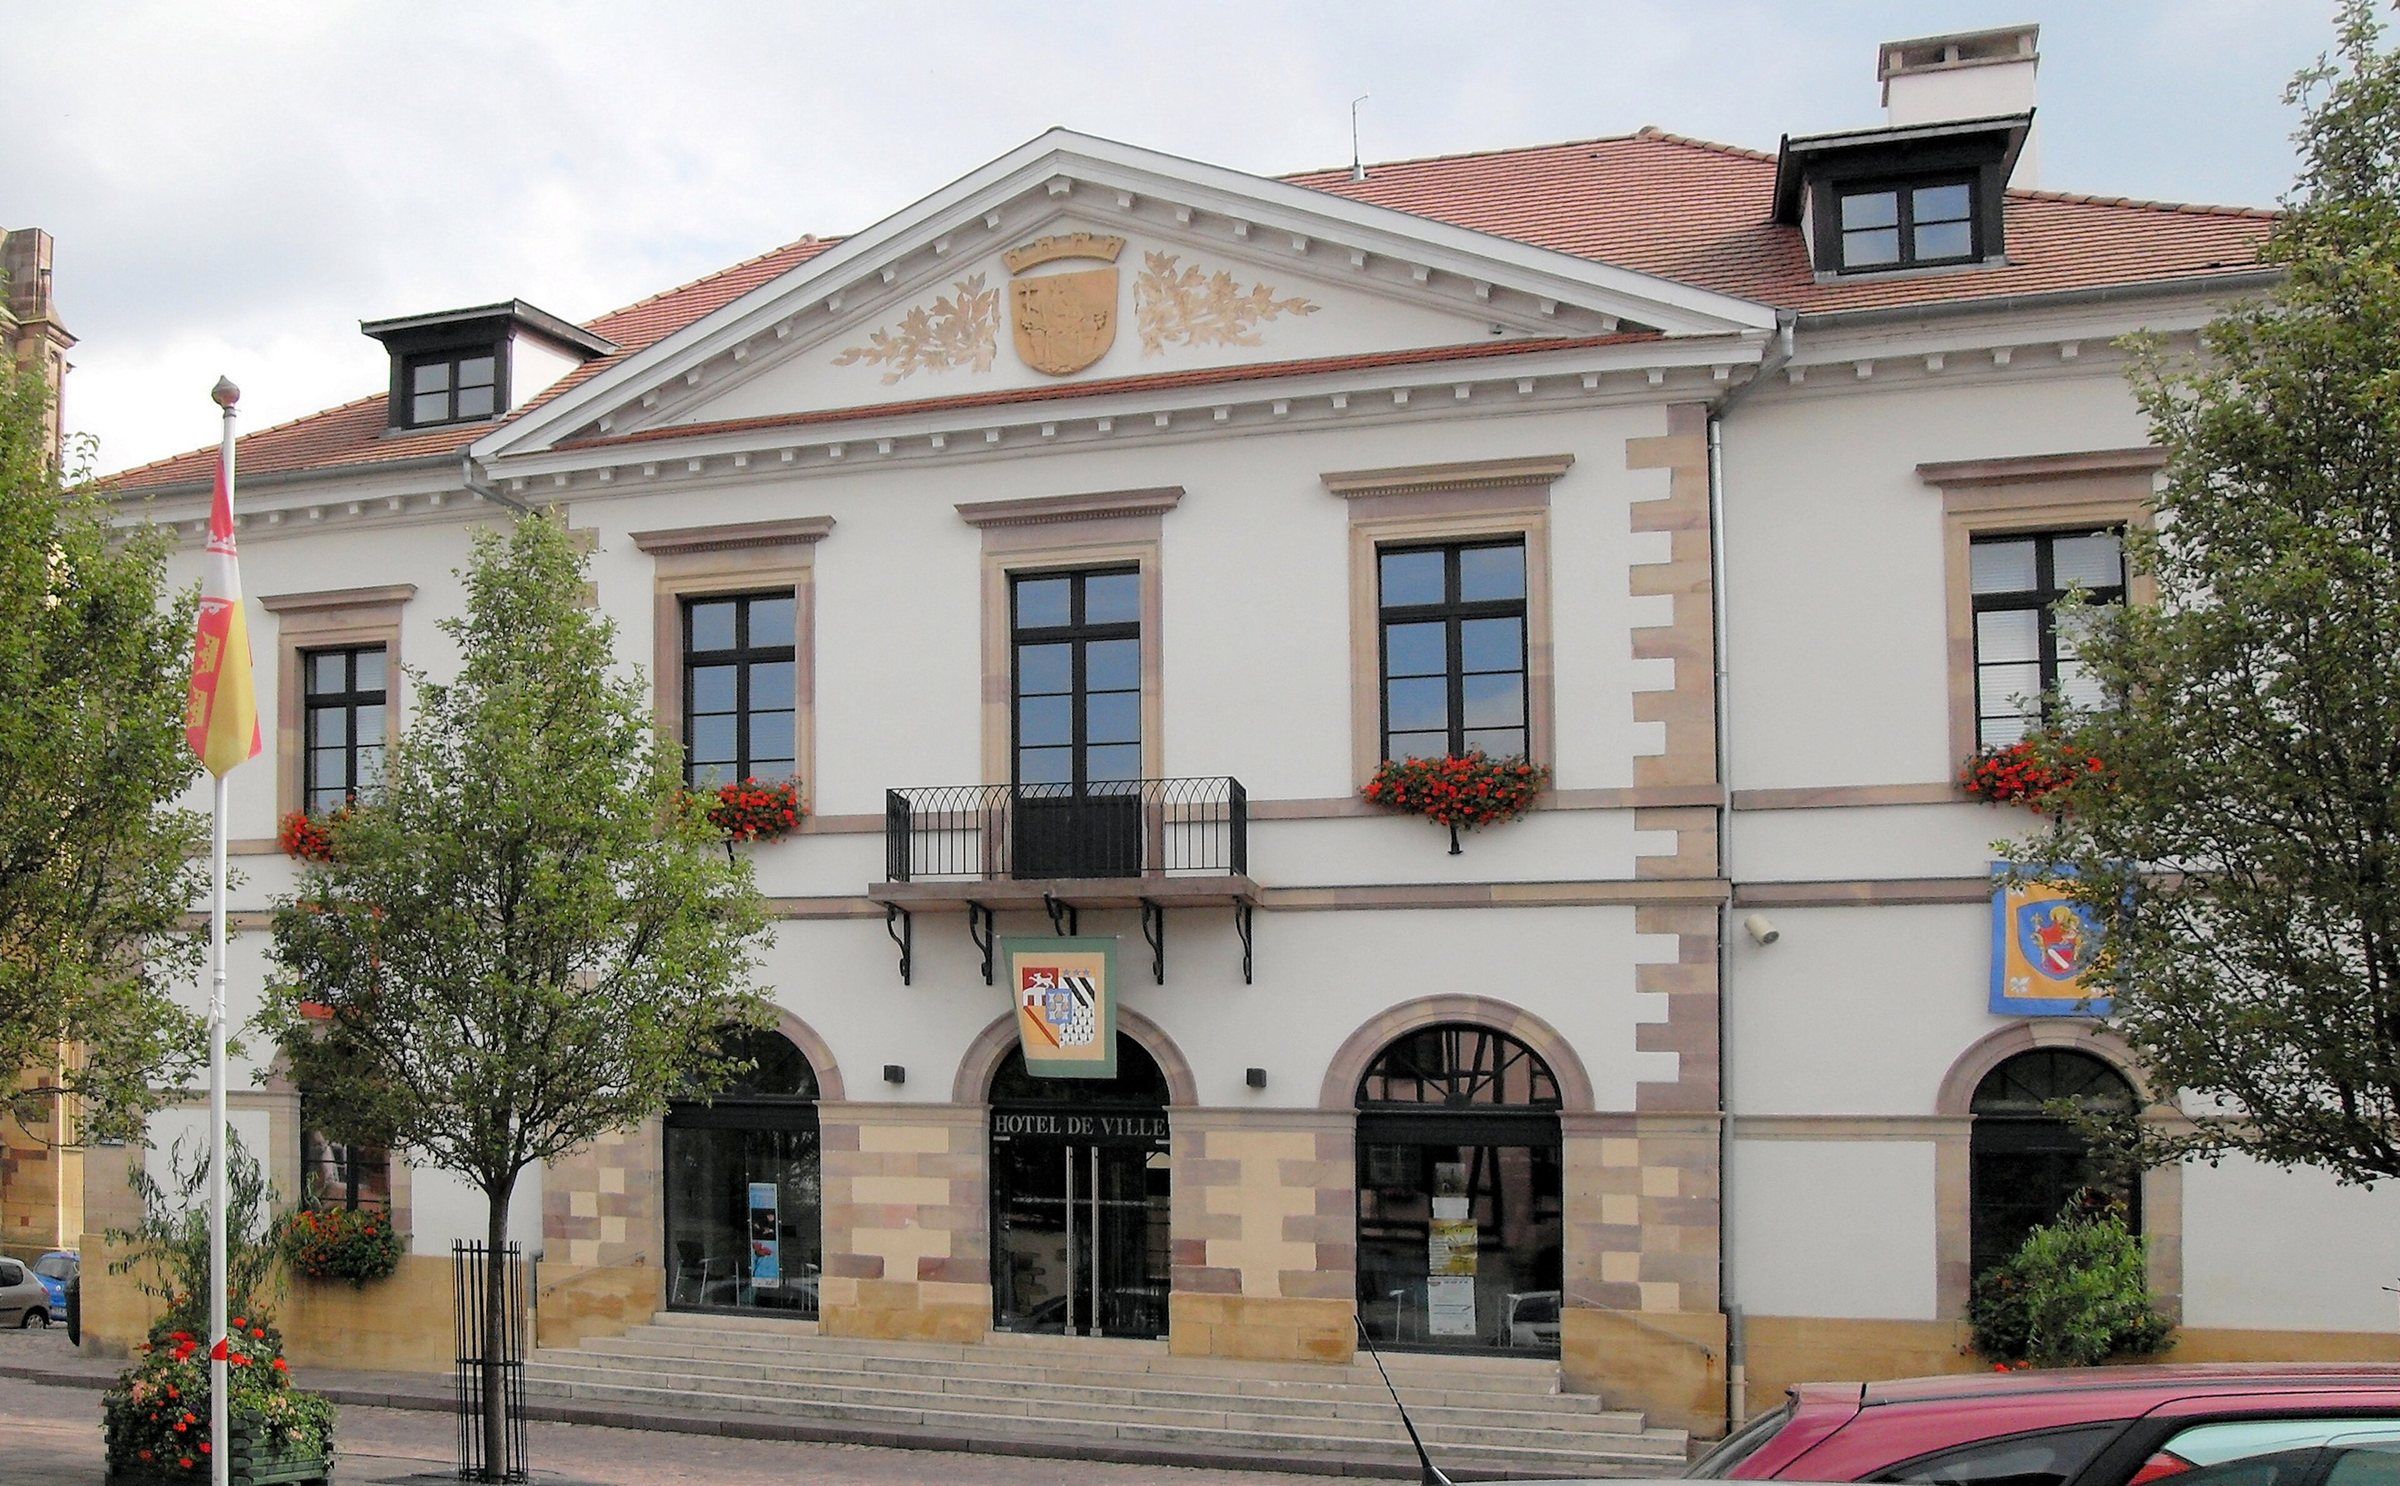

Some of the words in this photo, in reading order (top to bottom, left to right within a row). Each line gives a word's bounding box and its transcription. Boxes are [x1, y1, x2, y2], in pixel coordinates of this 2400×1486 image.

[994, 1115, 1061, 1134] HOTEL
[1067, 1116, 1094, 1135] DE
[1101, 1117, 1167, 1136] VILLE
